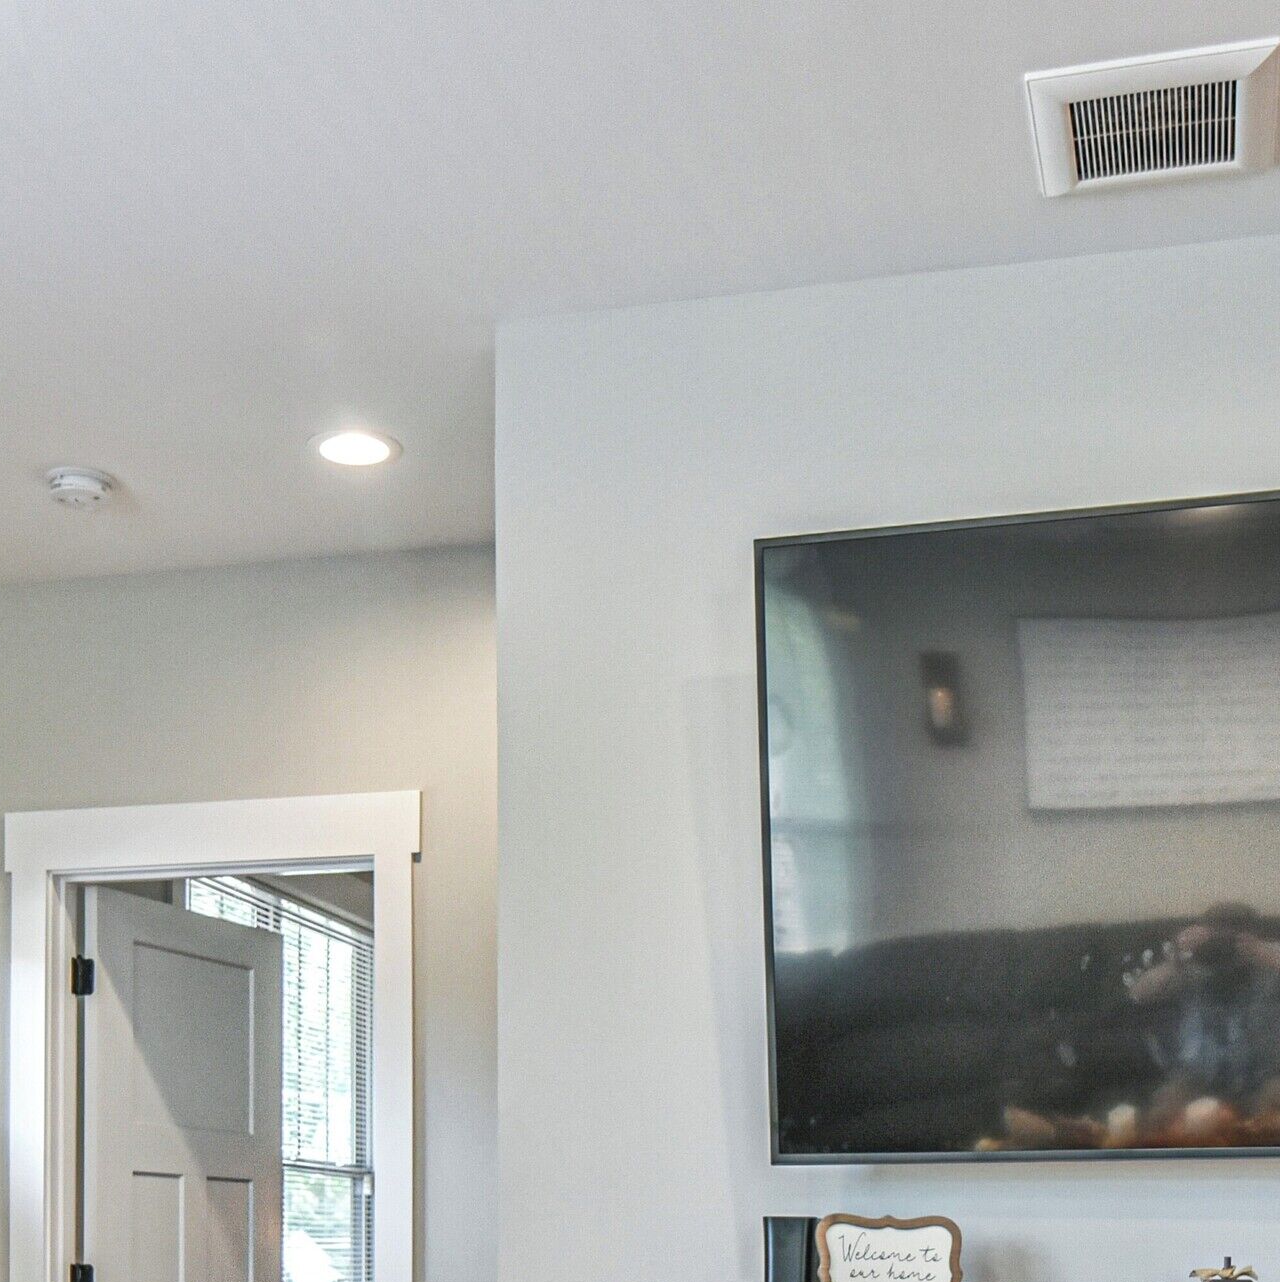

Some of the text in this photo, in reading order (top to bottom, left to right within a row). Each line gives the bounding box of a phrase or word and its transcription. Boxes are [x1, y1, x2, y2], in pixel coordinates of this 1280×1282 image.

[838, 1231, 943, 1263] Welcome to
[849, 1262, 937, 1281] our home
